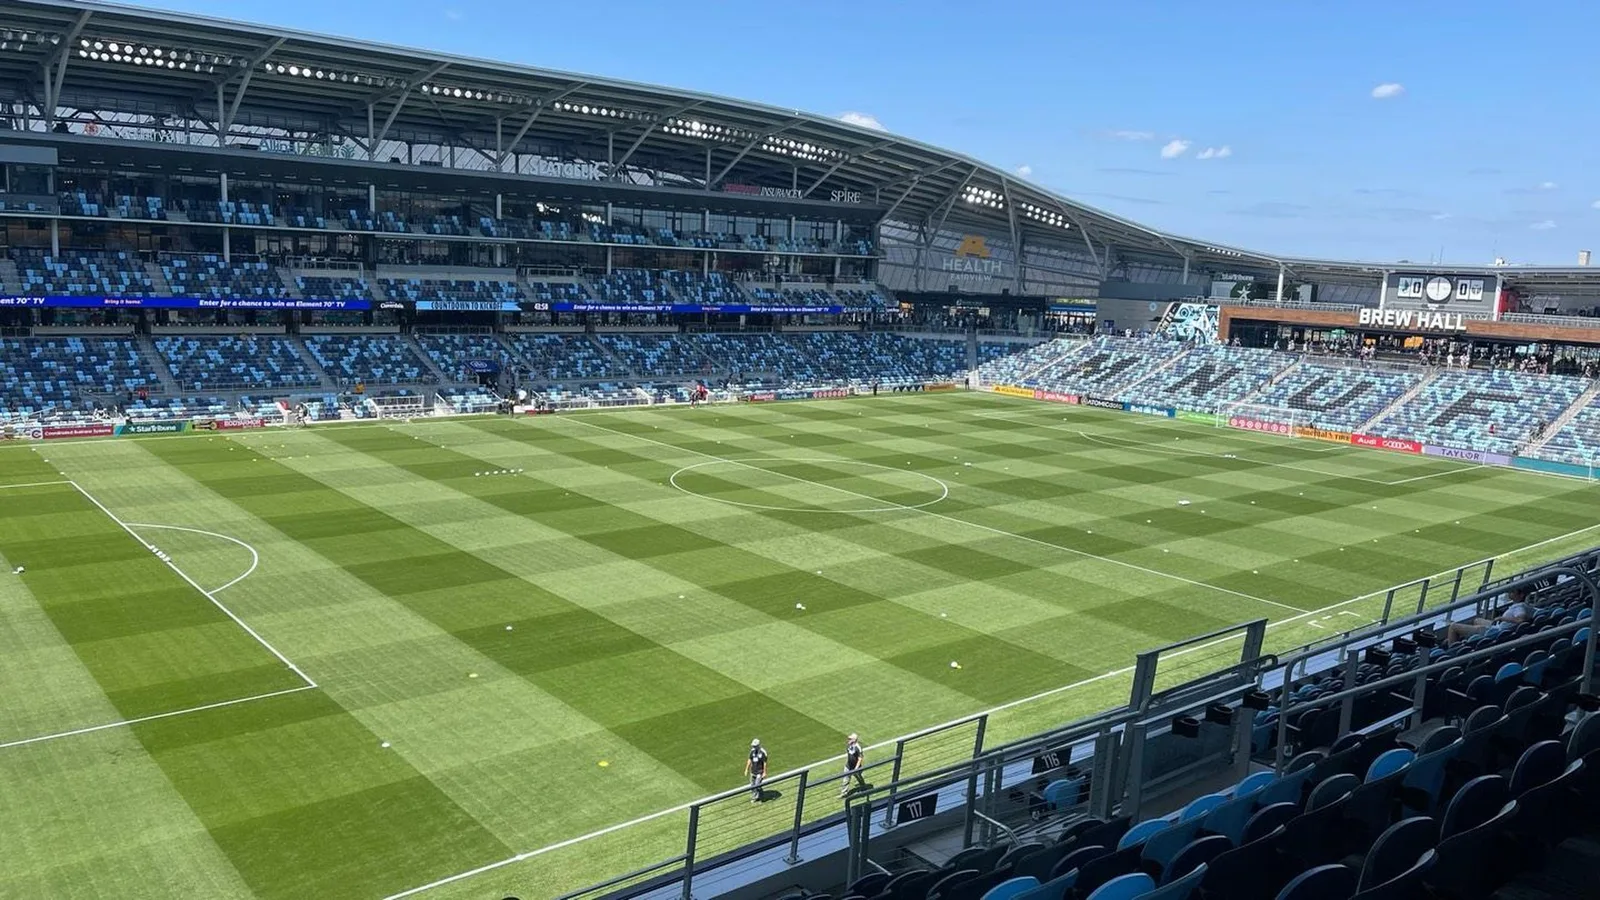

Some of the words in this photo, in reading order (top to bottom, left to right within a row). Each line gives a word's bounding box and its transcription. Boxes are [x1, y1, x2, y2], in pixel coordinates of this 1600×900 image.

[259, 139, 295, 154] Allina
[831, 189, 861, 204] SPIRE
[942, 258, 1001, 273] HEALTH
[220, 300, 231, 308] for
[431, 301, 471, 310] COUNTDOWN
[1360, 308, 1413, 326] BREW
[1417, 312, 1466, 331] HALL
[1152, 407, 1168, 417] Bank
[136, 425, 177, 433] StarTribune
[1358, 437, 1376, 445] Audi
[1441, 449, 1480, 460] TAYLOR
[1042, 753, 1060, 769] 116
[906, 801, 922, 819] 117
